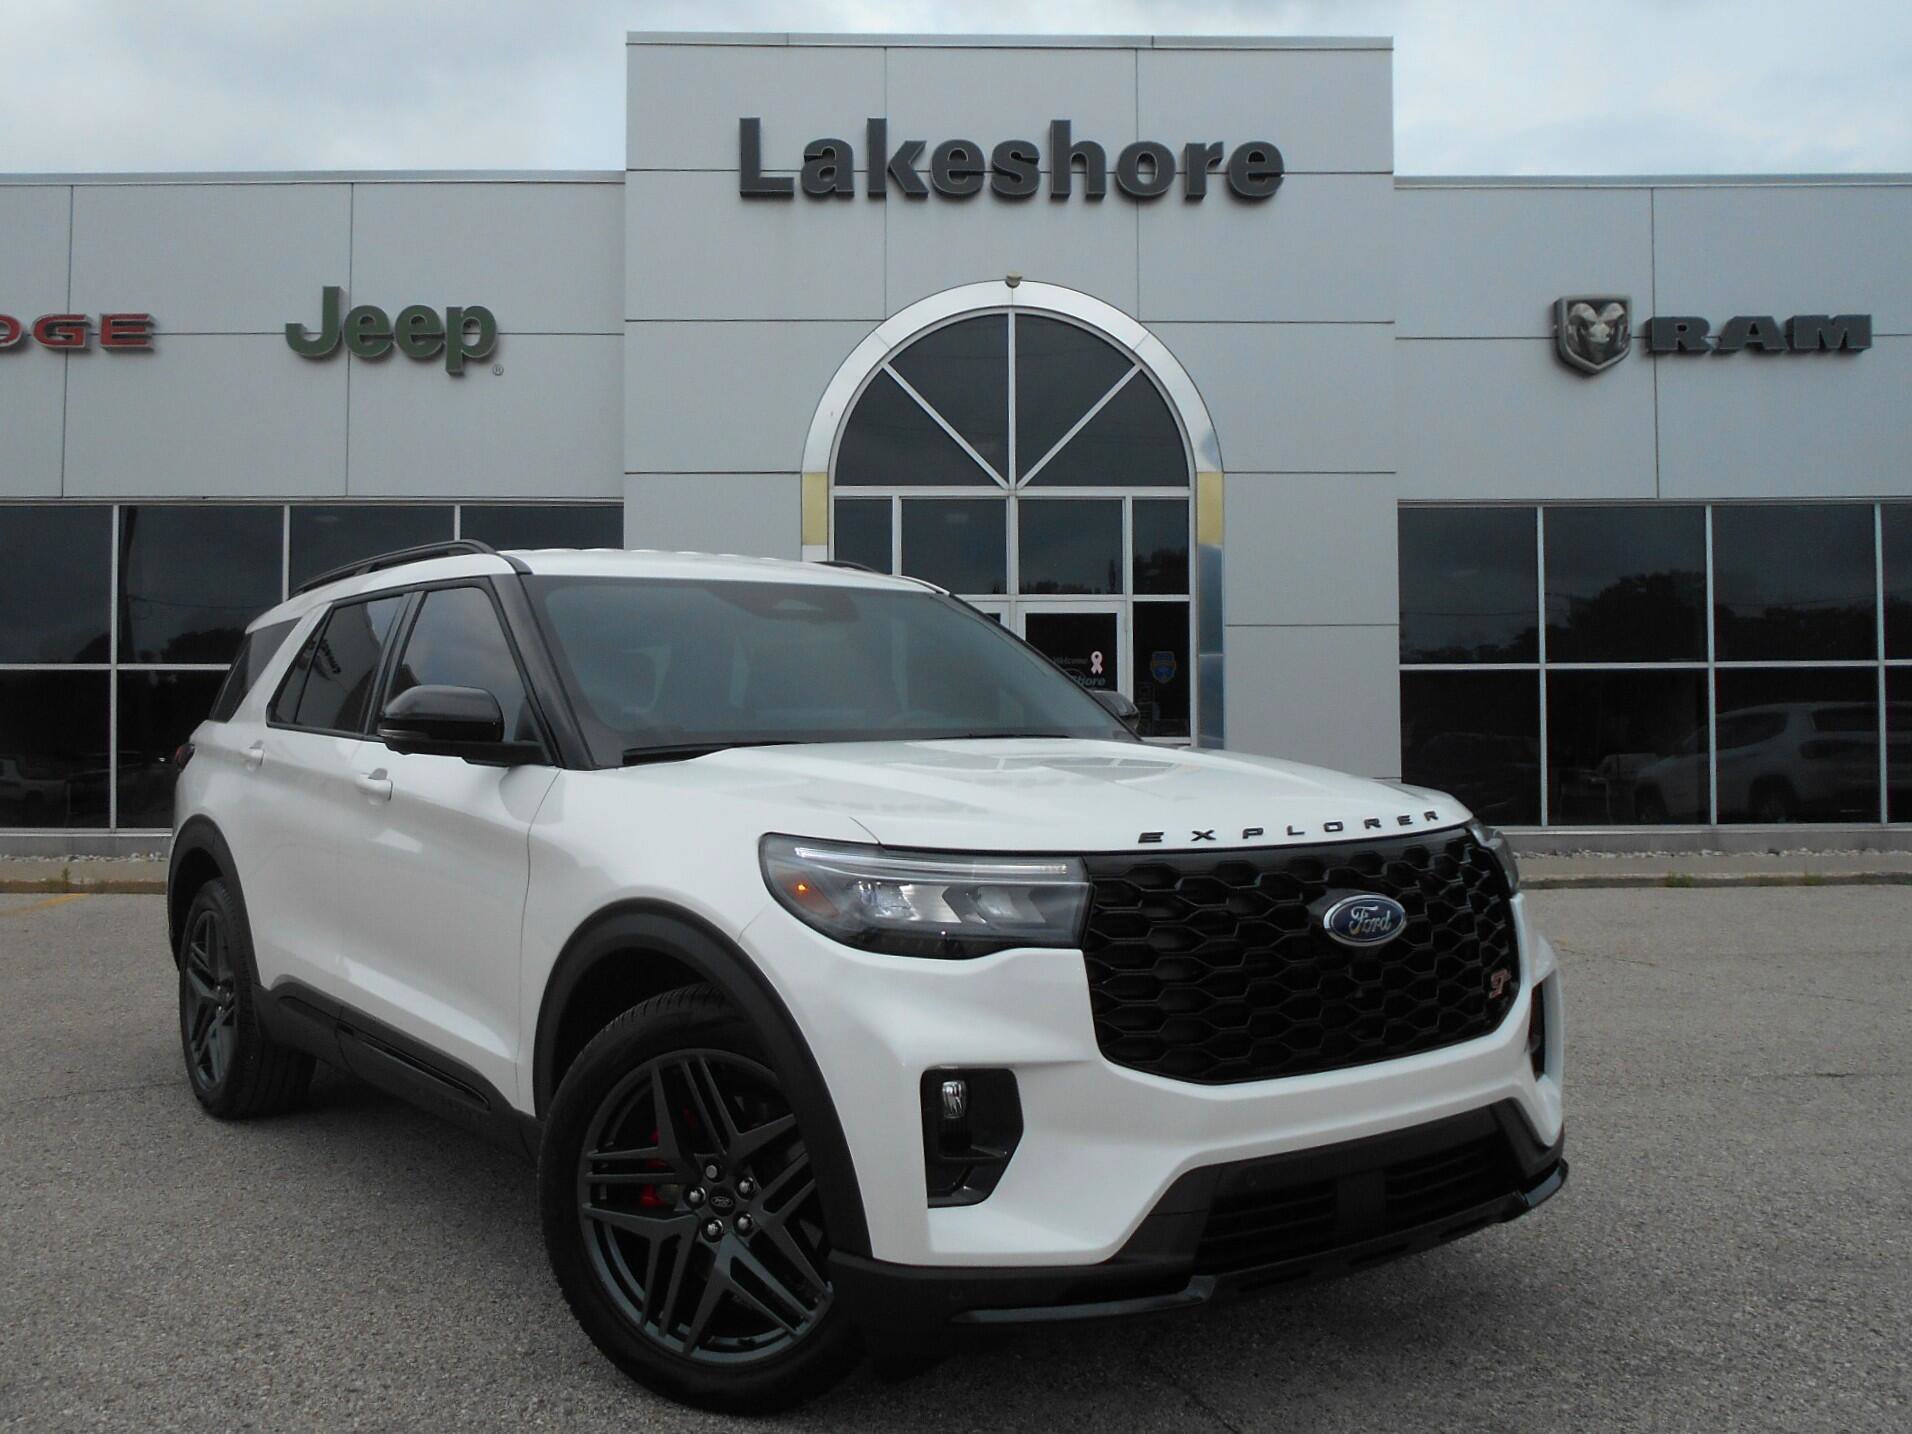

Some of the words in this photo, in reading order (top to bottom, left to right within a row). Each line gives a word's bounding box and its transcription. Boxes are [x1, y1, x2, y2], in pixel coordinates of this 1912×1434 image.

[739, 118, 1286, 200] Lakeshore
[284, 286, 497, 375] Jeep
[1647, 314, 1872, 354] RAM
[1138, 811, 1439, 844] EXPLORER
[1349, 906, 1392, 935] Ford
